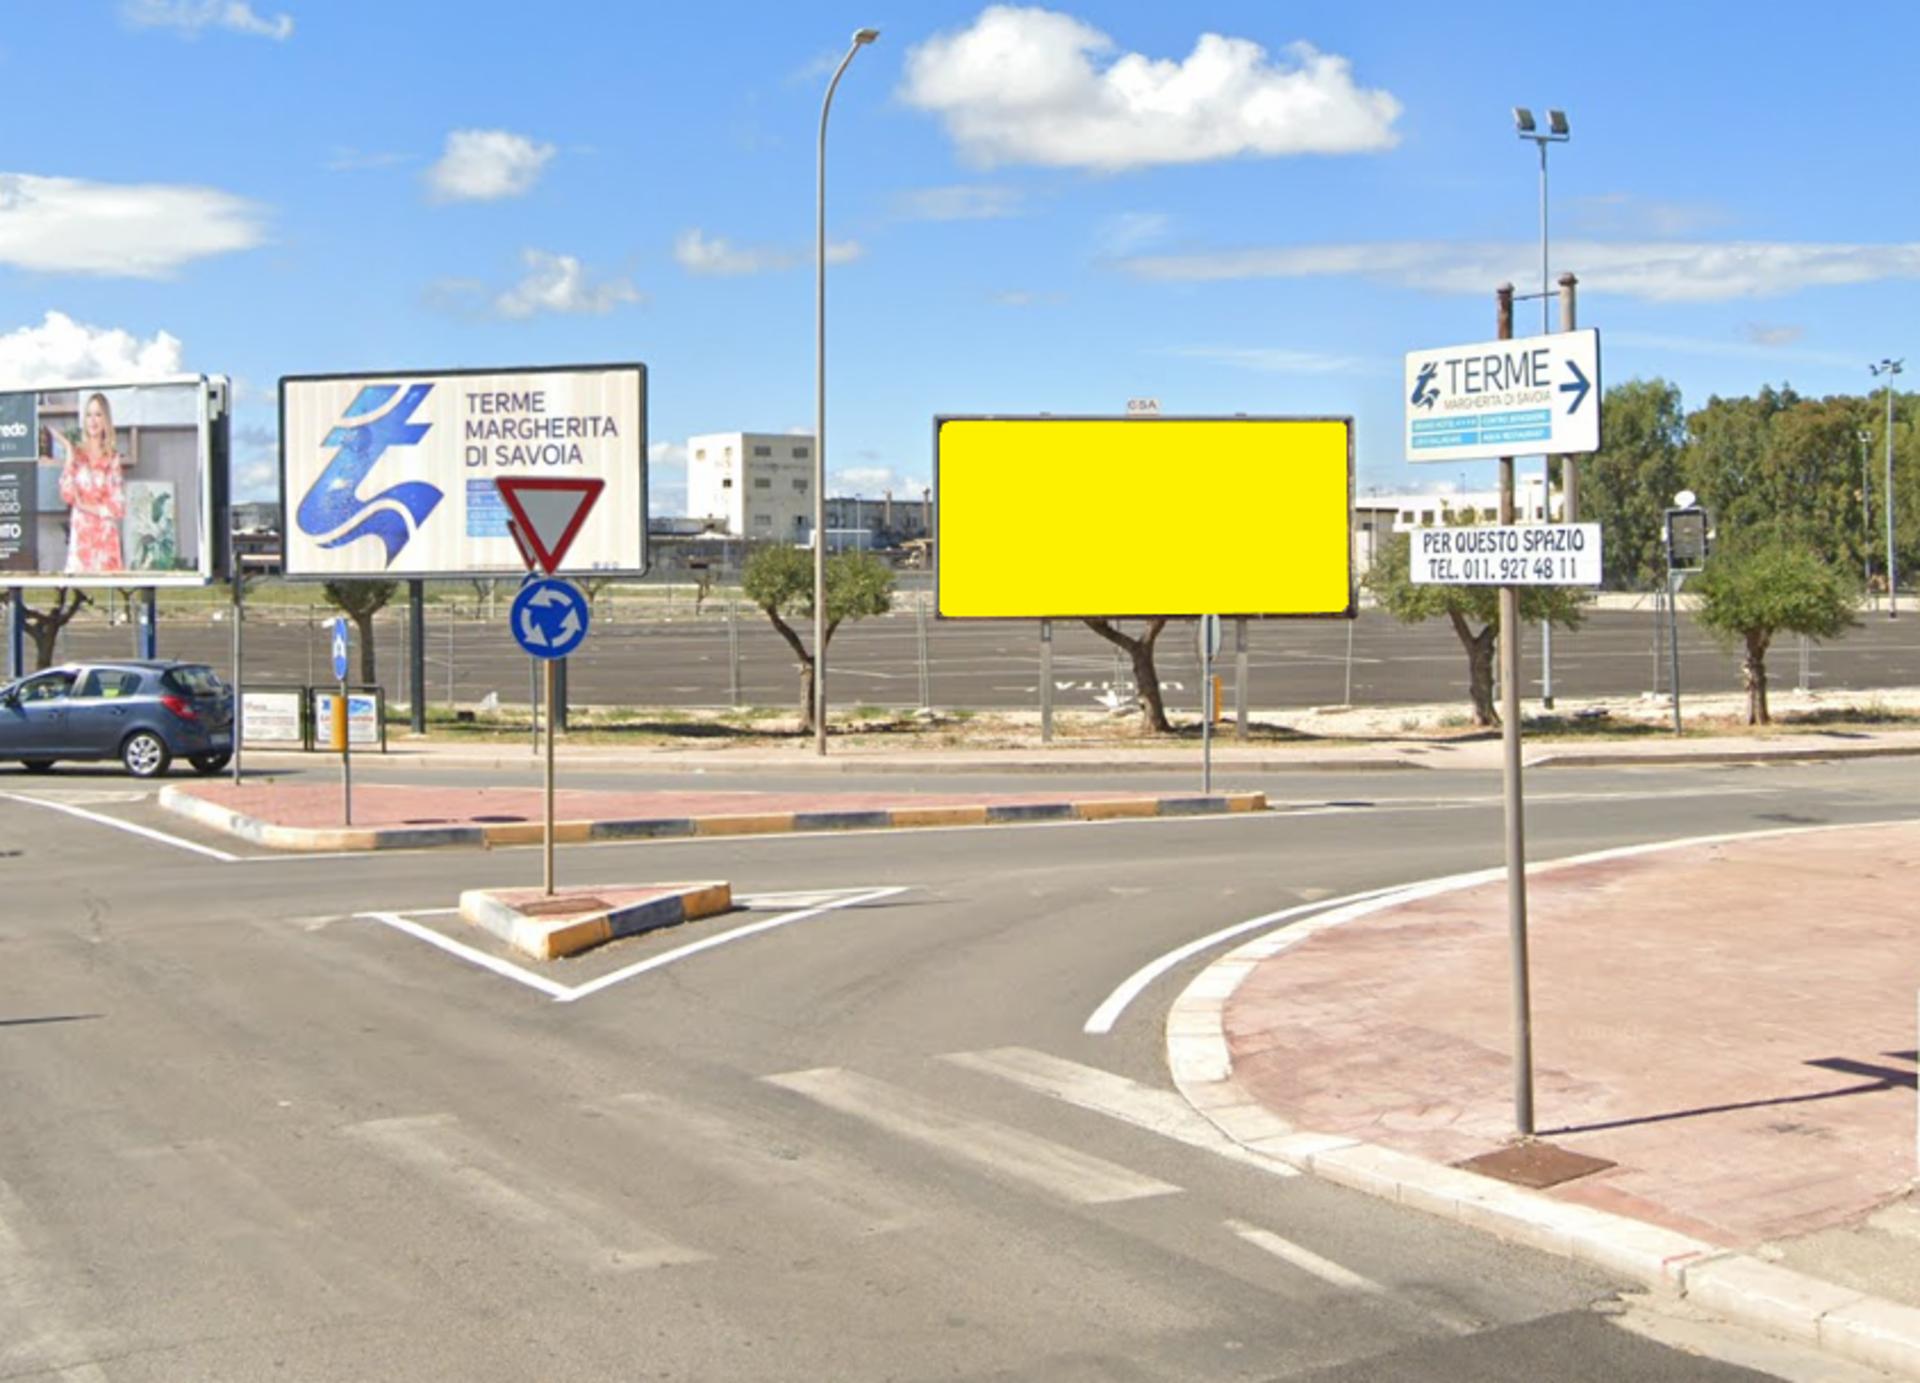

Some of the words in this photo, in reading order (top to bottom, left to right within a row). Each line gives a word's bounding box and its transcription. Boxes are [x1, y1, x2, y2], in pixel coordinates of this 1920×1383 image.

[1444, 348, 1551, 395] TERME
[466, 391, 545, 414] TERME
[466, 416, 618, 440] MARGHERITA
[465, 445, 488, 467] DI
[495, 444, 583, 467] SAVOIA
[1424, 532, 1450, 553] PER
[1456, 530, 1518, 553] QUESTO
[1523, 529, 1584, 551] SPAZIO
[1428, 558, 1459, 579] TEL.
[1463, 558, 1495, 579] 011.
[1500, 558, 1528, 579] 927
[1533, 557, 1553, 579] 48
[1560, 557, 1577, 578] 11
